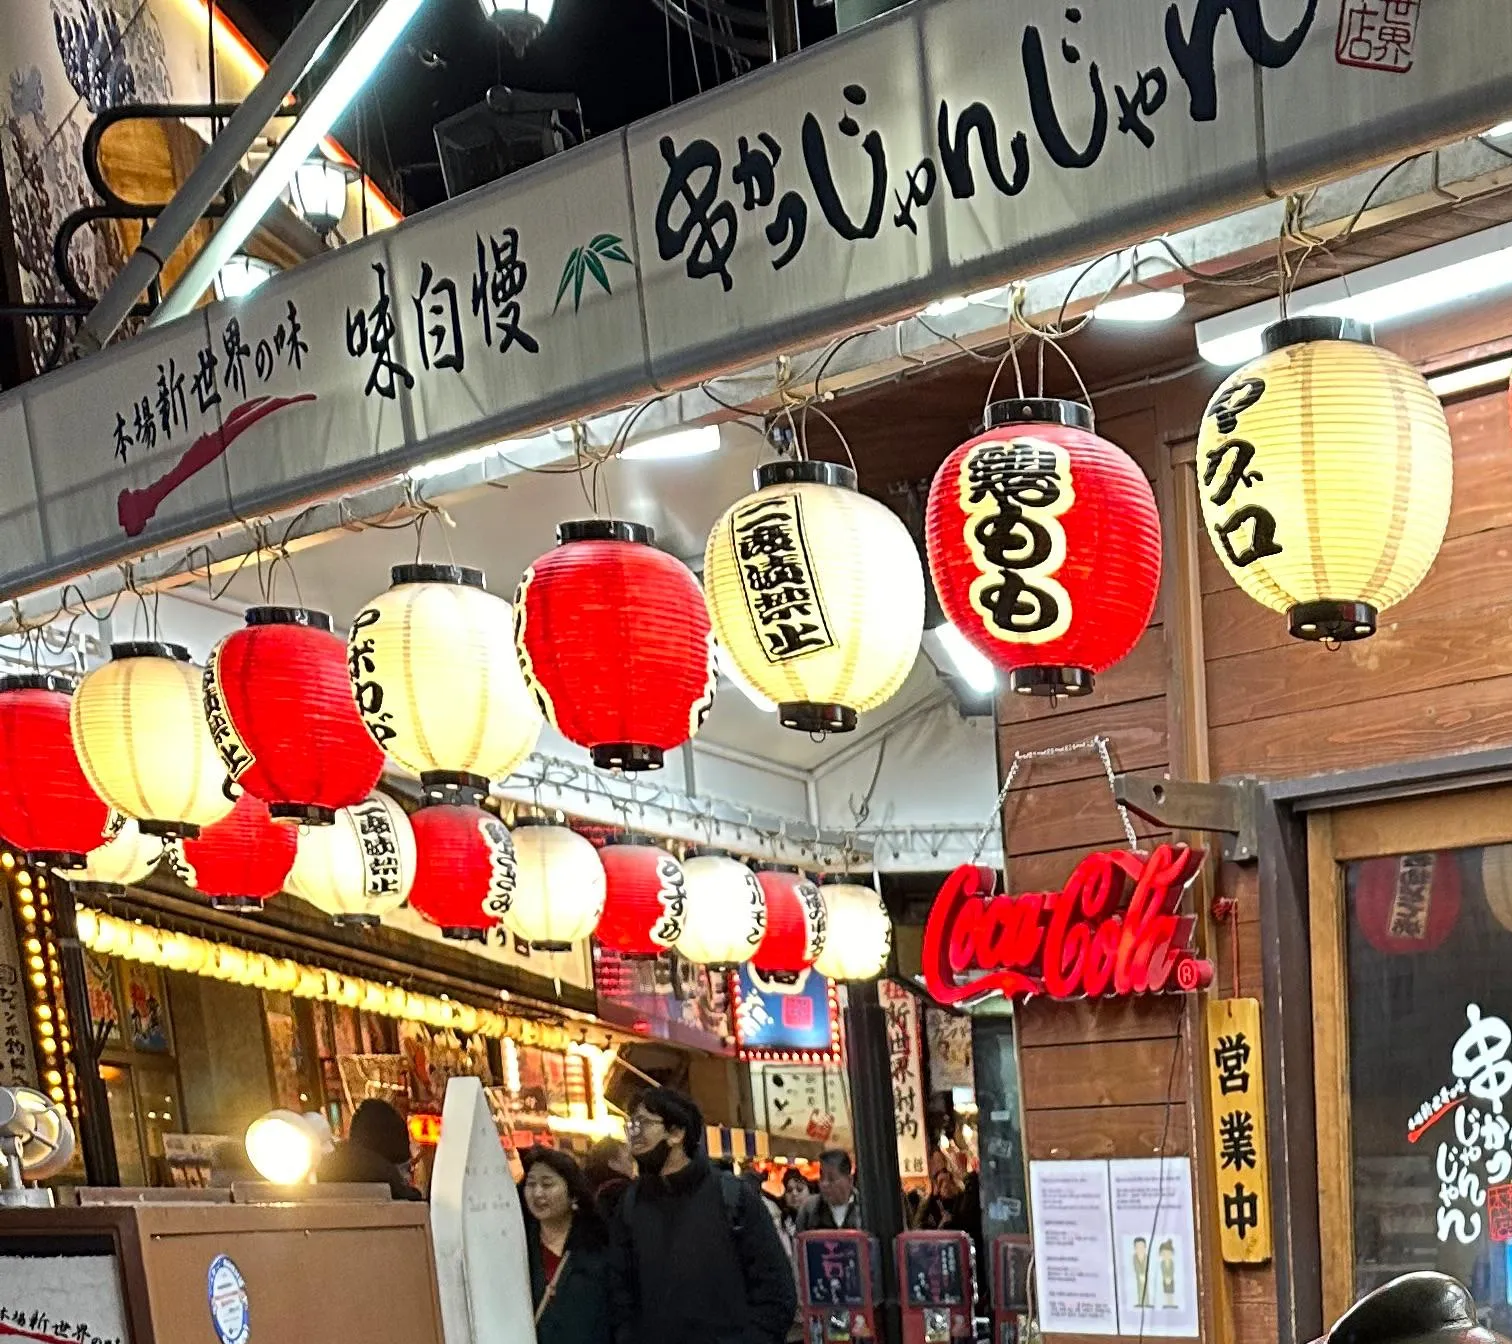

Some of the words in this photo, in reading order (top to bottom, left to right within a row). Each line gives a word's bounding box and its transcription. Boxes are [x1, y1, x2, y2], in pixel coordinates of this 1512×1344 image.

[655, 0, 1317, 292] 串かつじゃんじゃん
[113, 300, 309, 464] 本場新世界の味
[346, 227, 540, 399] 味自慢
[1204, 377, 1283, 567] マグロ
[736, 500, 826, 656] 二度漬禁止
[922, 843, 1202, 1006] Coca-Cola
[1214, 1032, 1258, 1240] 営業中
[1436, 1142, 1482, 1244] じゃん
[1455, 1105, 1488, 1208] じゃん
